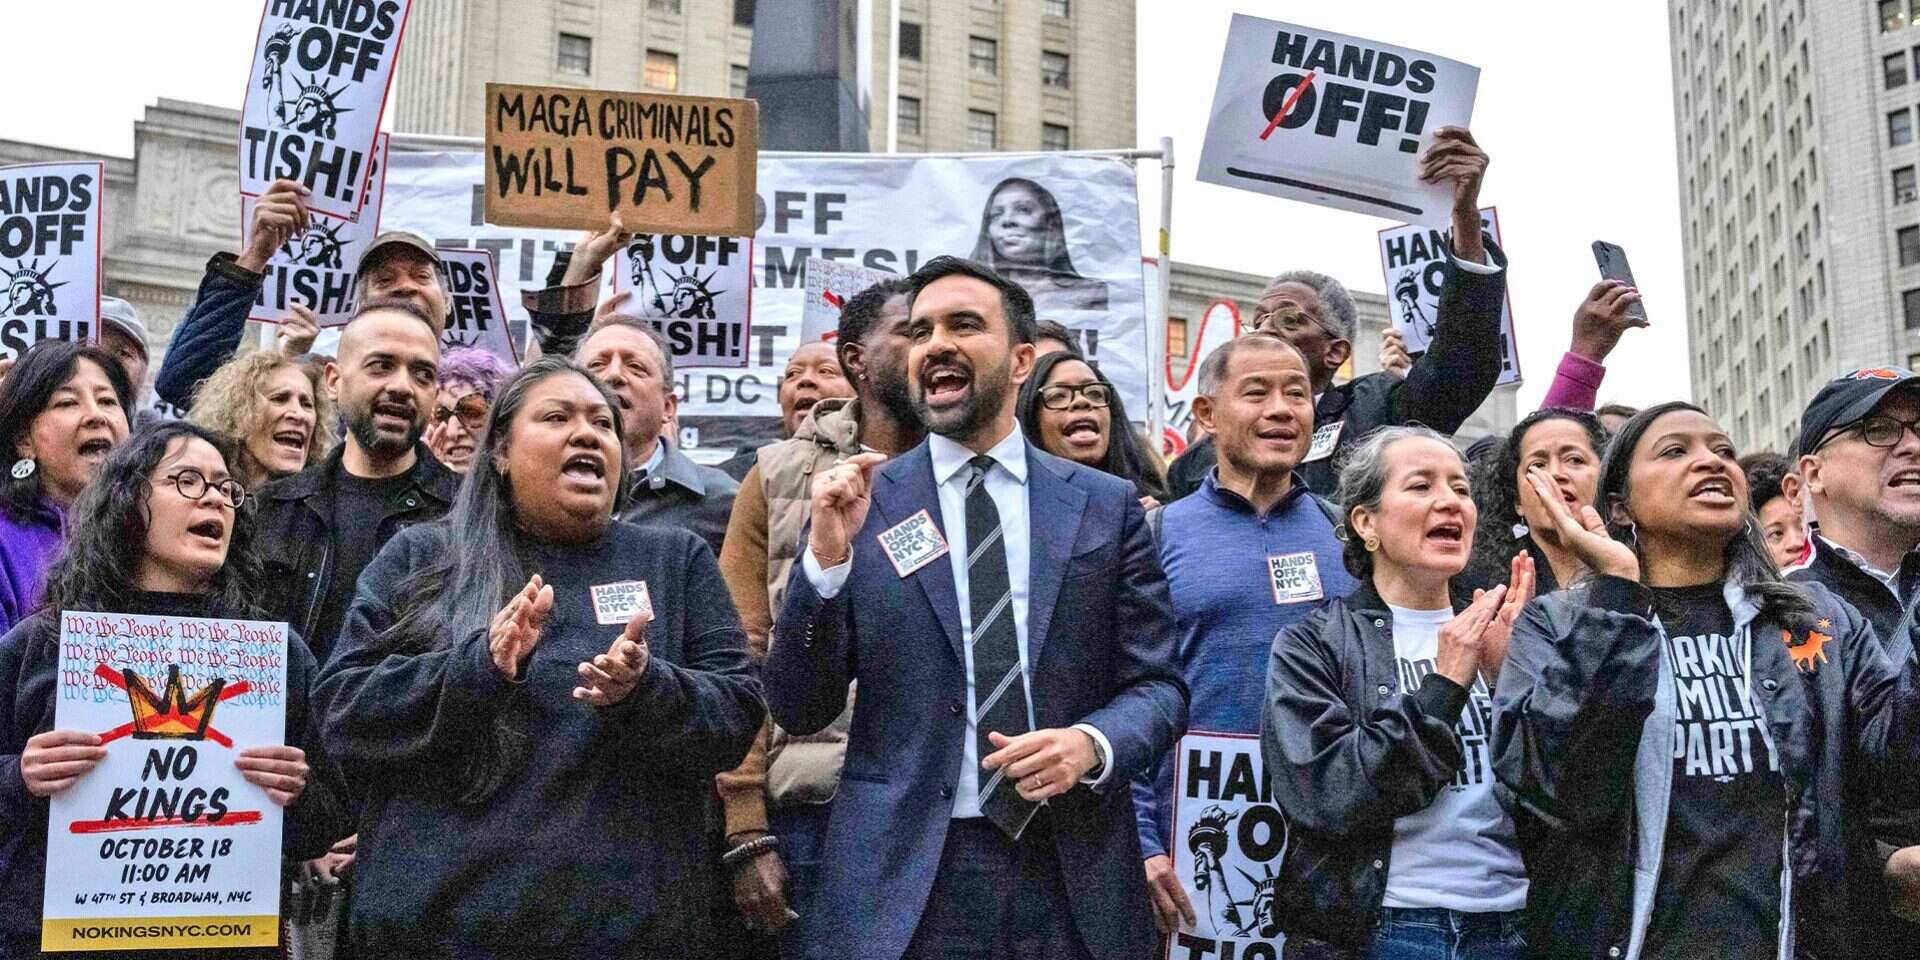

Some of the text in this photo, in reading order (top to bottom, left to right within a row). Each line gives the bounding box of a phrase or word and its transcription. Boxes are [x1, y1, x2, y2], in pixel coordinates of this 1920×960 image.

[297, 27, 385, 83] OFF
[1272, 31, 1437, 94] HANDS
[497, 93, 735, 148] MAGA CRIMINALS
[1263, 73, 1431, 154] OFF!
[245, 126, 363, 203] TISH!
[492, 145, 716, 213] WILL PAY
[755, 190, 847, 236] FF
[0, 214, 87, 259] OFF
[706, 374, 761, 404] DC
[882, 513, 927, 544] HANDS
[888, 532, 914, 551] OFF
[893, 541, 923, 562] NYC
[1271, 554, 1313, 569] HANDS
[1274, 567, 1297, 578] OFF
[1275, 577, 1302, 589] NYC
[595, 584, 644, 596] HANDS
[597, 594, 625, 604] OFF
[599, 602, 629, 613] NYC
[65, 616, 93, 635] We
[118, 618, 174, 641] People
[178, 622, 206, 639] We
[230, 623, 282, 645] People
[141, 745, 198, 782] NO
[104, 786, 230, 823] KINGS
[100, 838, 233, 860] OCTOBER 18
[121, 863, 212, 884] 11:00 AM
[75, 893, 88, 905] W
[119, 892, 136, 905] ST
[150, 891, 223, 905] BROADWAY,
[227, 891, 252, 903] NYC
[72, 924, 252, 940] NOKINGSNYC.COM
